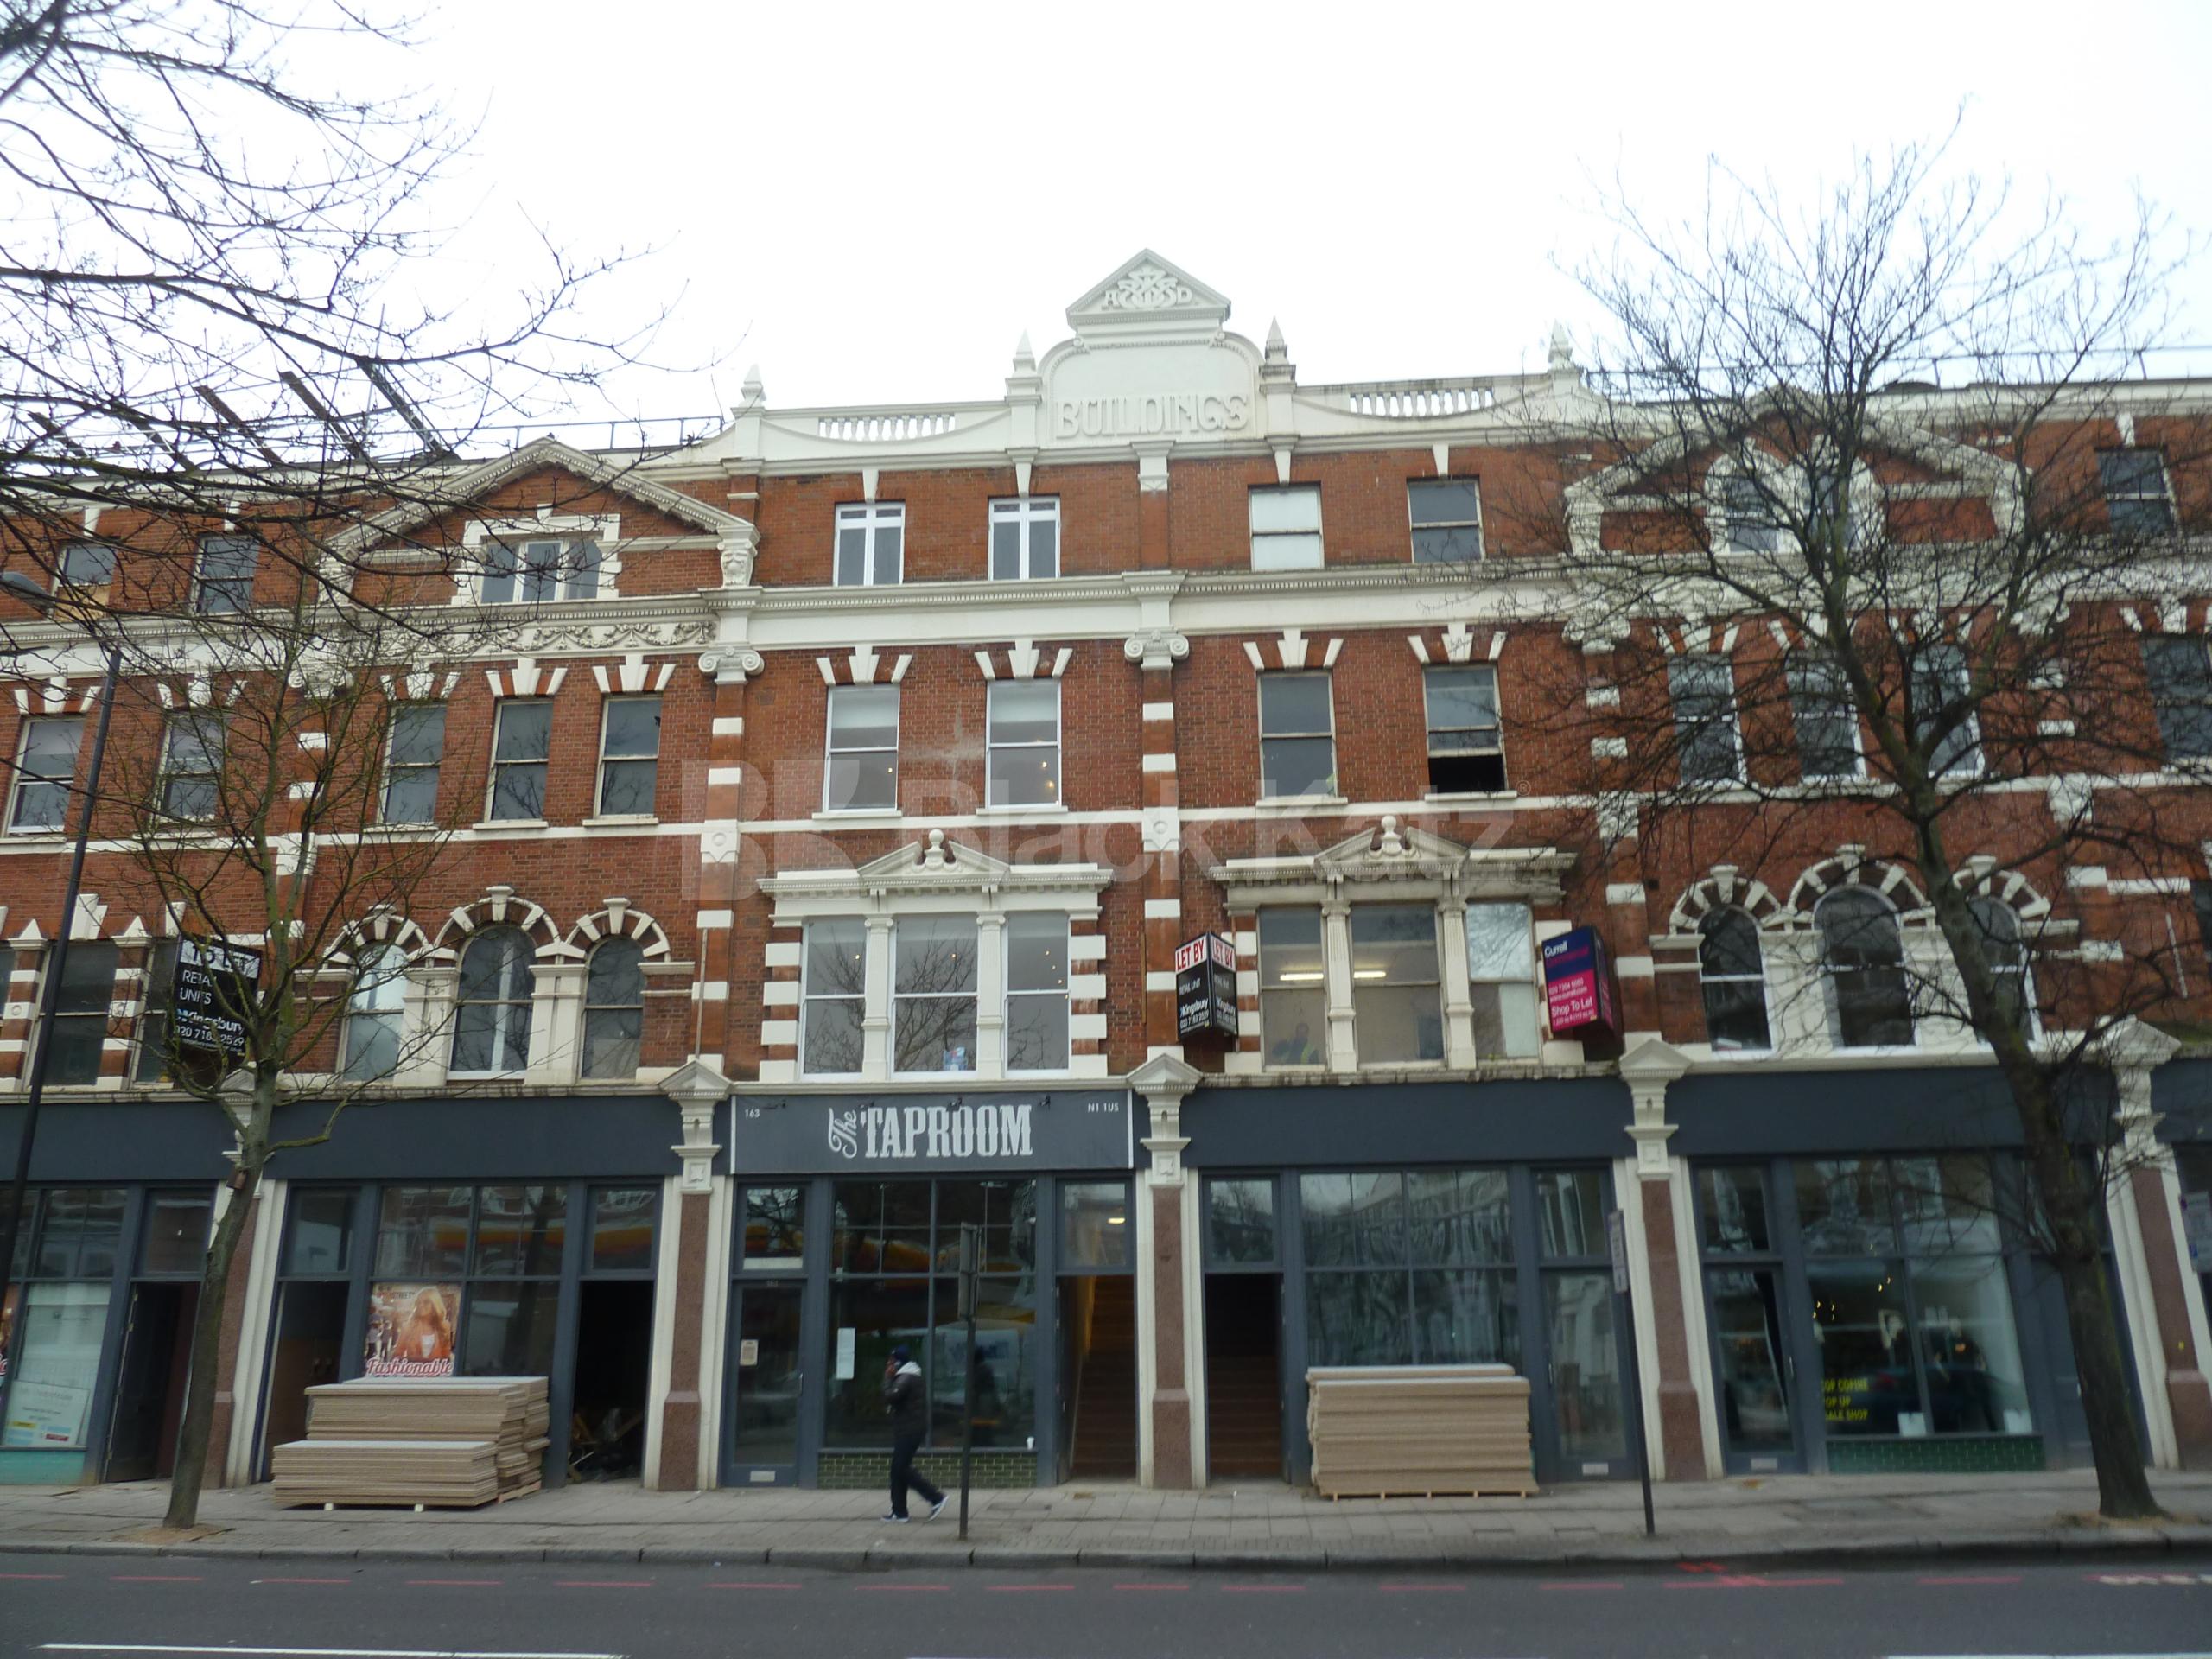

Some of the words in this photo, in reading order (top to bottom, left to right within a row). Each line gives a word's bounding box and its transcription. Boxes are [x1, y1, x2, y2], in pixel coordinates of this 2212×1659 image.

[1056, 394, 1248, 439] BUILDINGS
[1177, 948, 1191, 970] LET
[1193, 939, 1204, 963] BY
[1213, 940, 1224, 963] LET
[1544, 940, 1568, 958] Currell
[182, 969, 218, 988] RETA
[180, 987, 212, 1004] UNIS
[1552, 1004, 1569, 1017] Shop
[1572, 1000, 1580, 1010] To
[1581, 996, 1592, 1008] Let
[194, 1028, 217, 1042] 718
[745, 1109, 760, 1118] 163
[1088, 1102, 1098, 1113] N1
[828, 1108, 858, 1159] The
[860, 1104, 1033, 1159] TAPROOM
[366, 1357, 454, 1376] Fashionable
